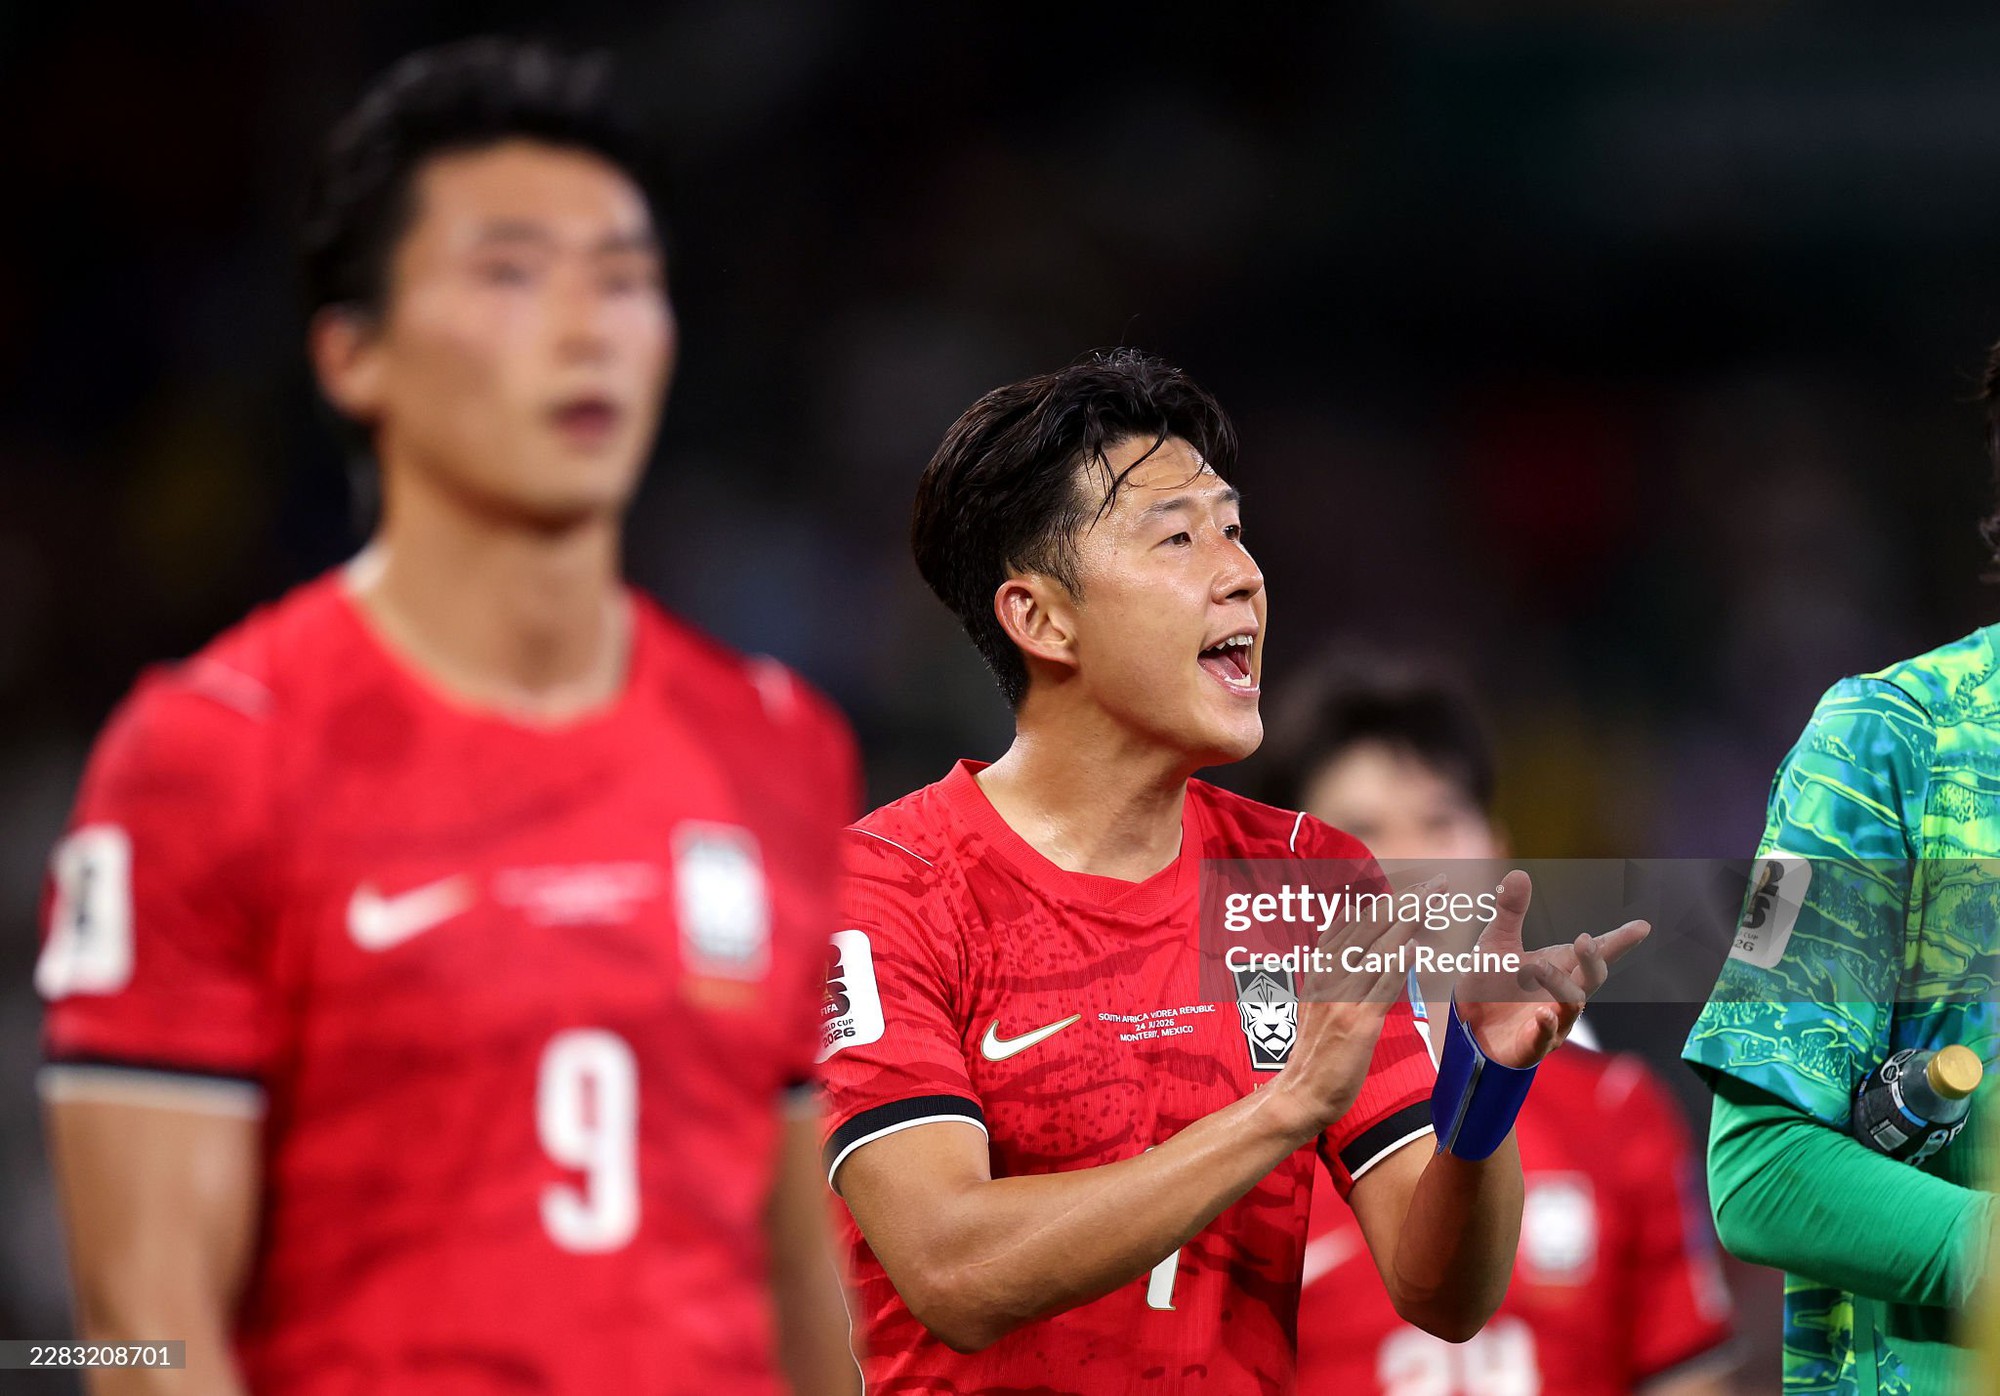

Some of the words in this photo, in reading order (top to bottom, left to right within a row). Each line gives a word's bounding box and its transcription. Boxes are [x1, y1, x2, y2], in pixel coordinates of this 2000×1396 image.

[820, 1003, 839, 1017] FIFA
[837, 1018, 854, 1027] CUP
[1098, 1013, 1120, 1022] SOUTH
[1122, 1013, 1149, 1023] AFRICA
[1135, 1023, 1146, 1032] 24
[1161, 1025, 1193, 1037] MEXICO
[823, 1027, 856, 1048] 2026
[537, 1026, 639, 1253] 9
